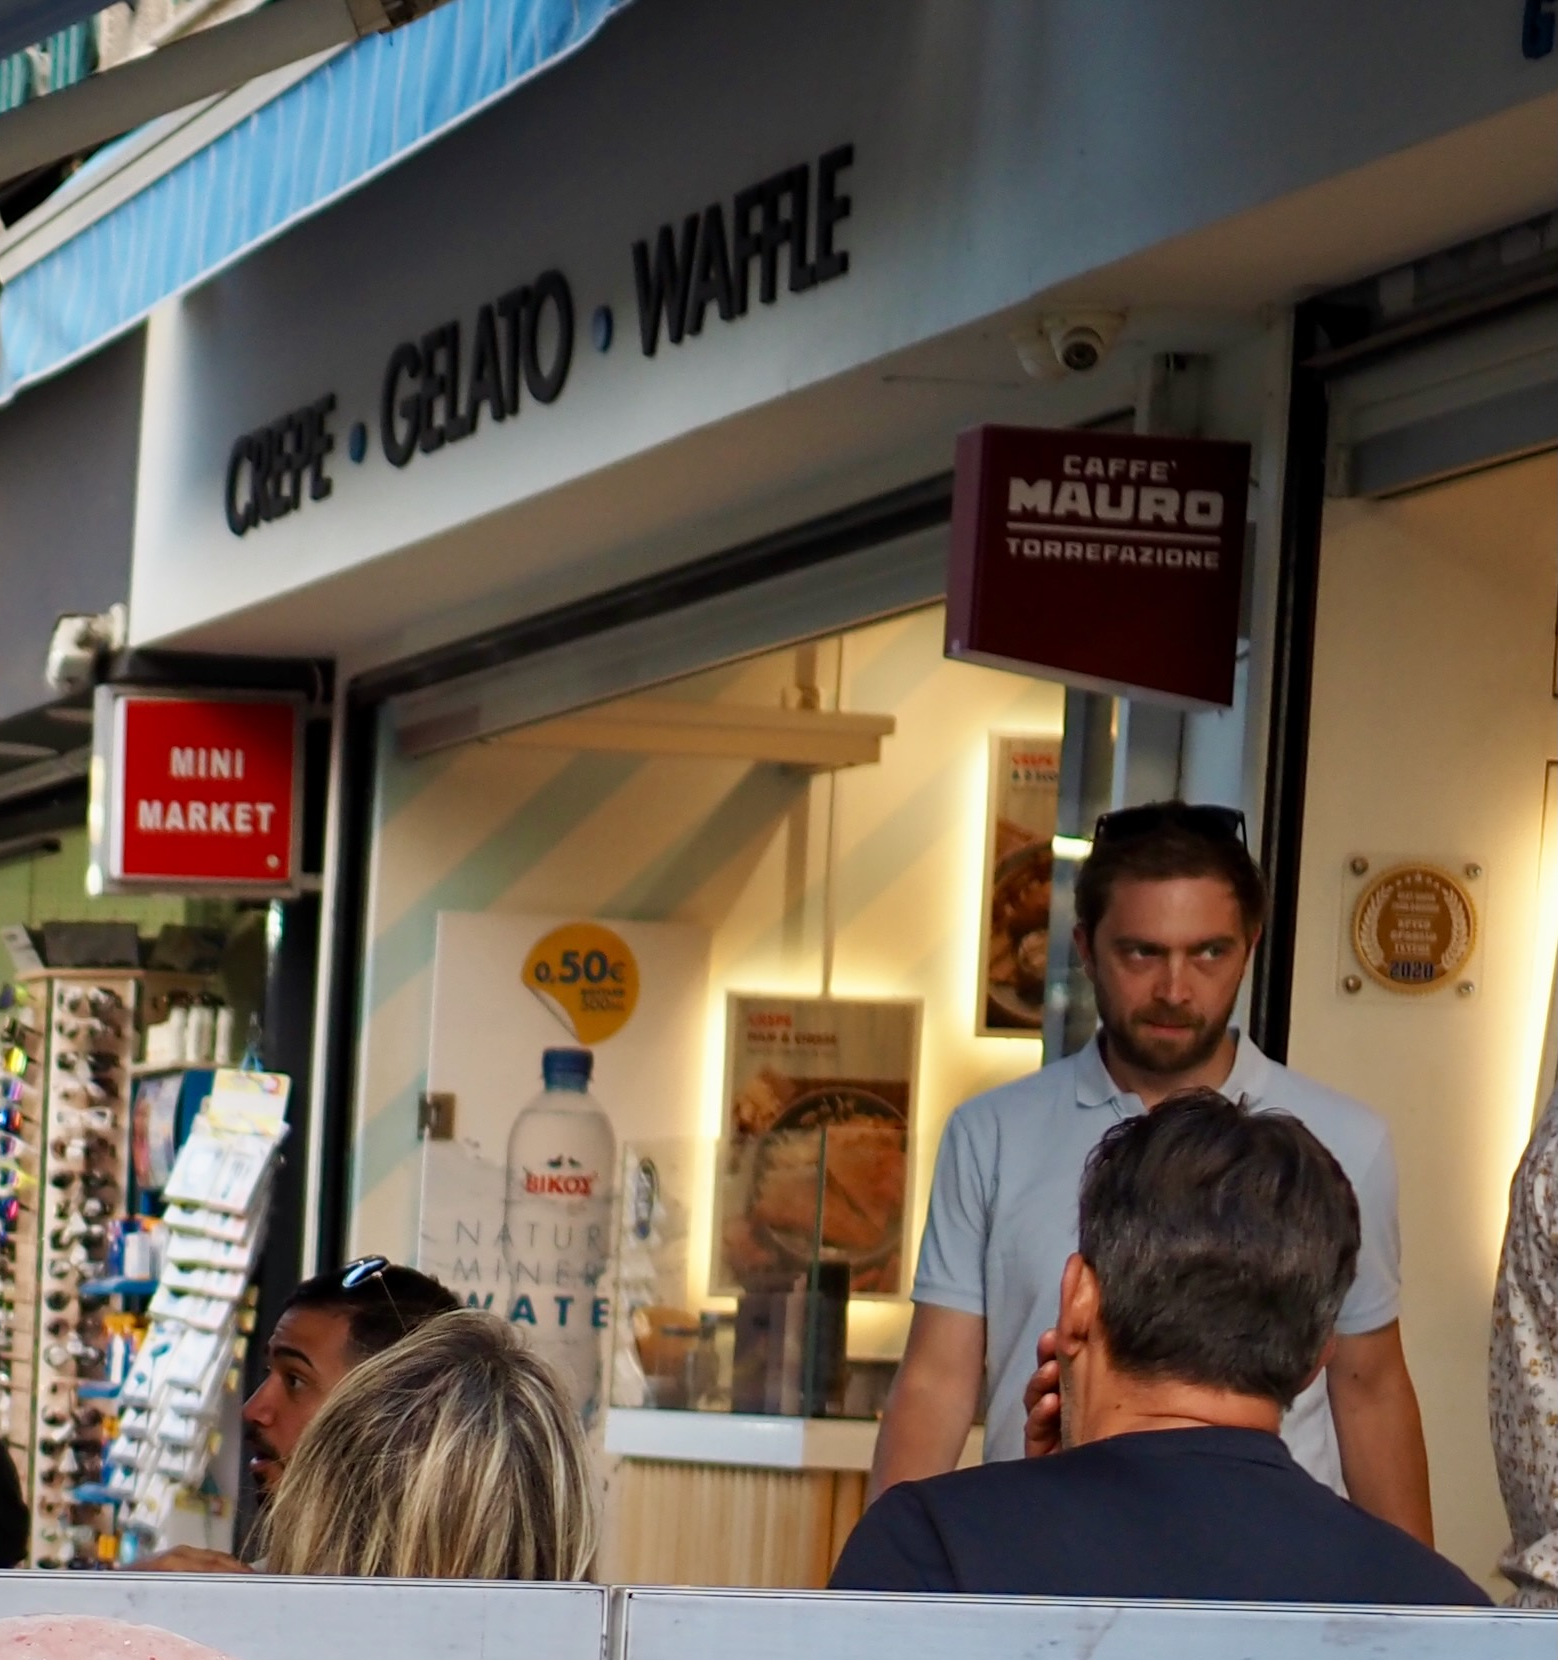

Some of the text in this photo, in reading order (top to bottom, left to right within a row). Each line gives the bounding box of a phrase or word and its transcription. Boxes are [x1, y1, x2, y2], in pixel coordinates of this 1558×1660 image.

[225, 142, 855, 538] CREPE GELATO WAFFLE
[1007, 476, 1224, 528] MAURO
[1005, 536, 1221, 570] TORREFAZIONE
[170, 746, 245, 780] MINI
[138, 799, 276, 834] MARKET
